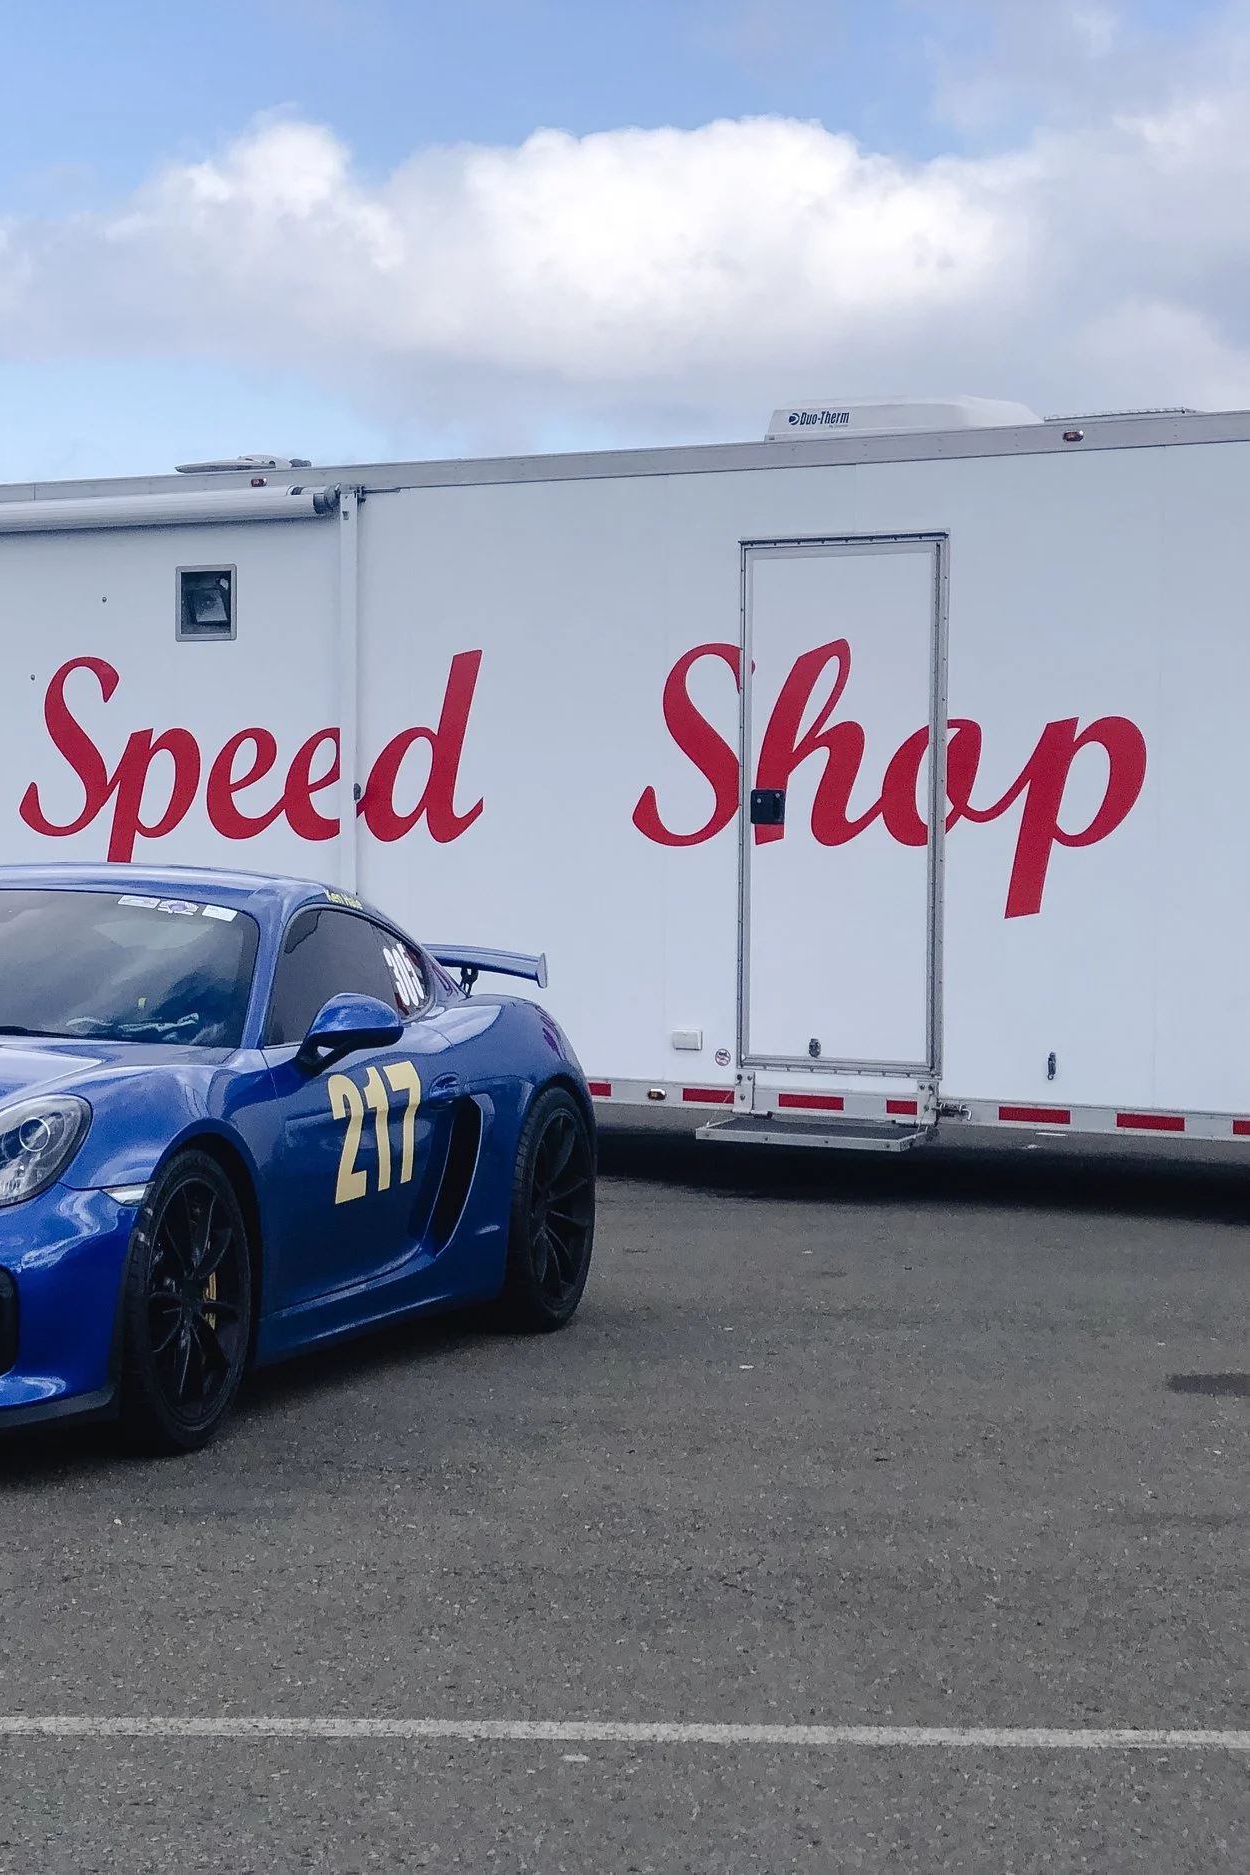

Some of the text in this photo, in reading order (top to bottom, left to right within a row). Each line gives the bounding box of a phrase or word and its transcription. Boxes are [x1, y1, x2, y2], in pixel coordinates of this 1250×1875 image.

[799, 411, 850, 426] Duo-Therm
[19, 649, 484, 864] Speed
[633, 638, 1148, 919] Shop
[382, 943, 425, 1007] 305
[327, 1060, 421, 1205] 217
